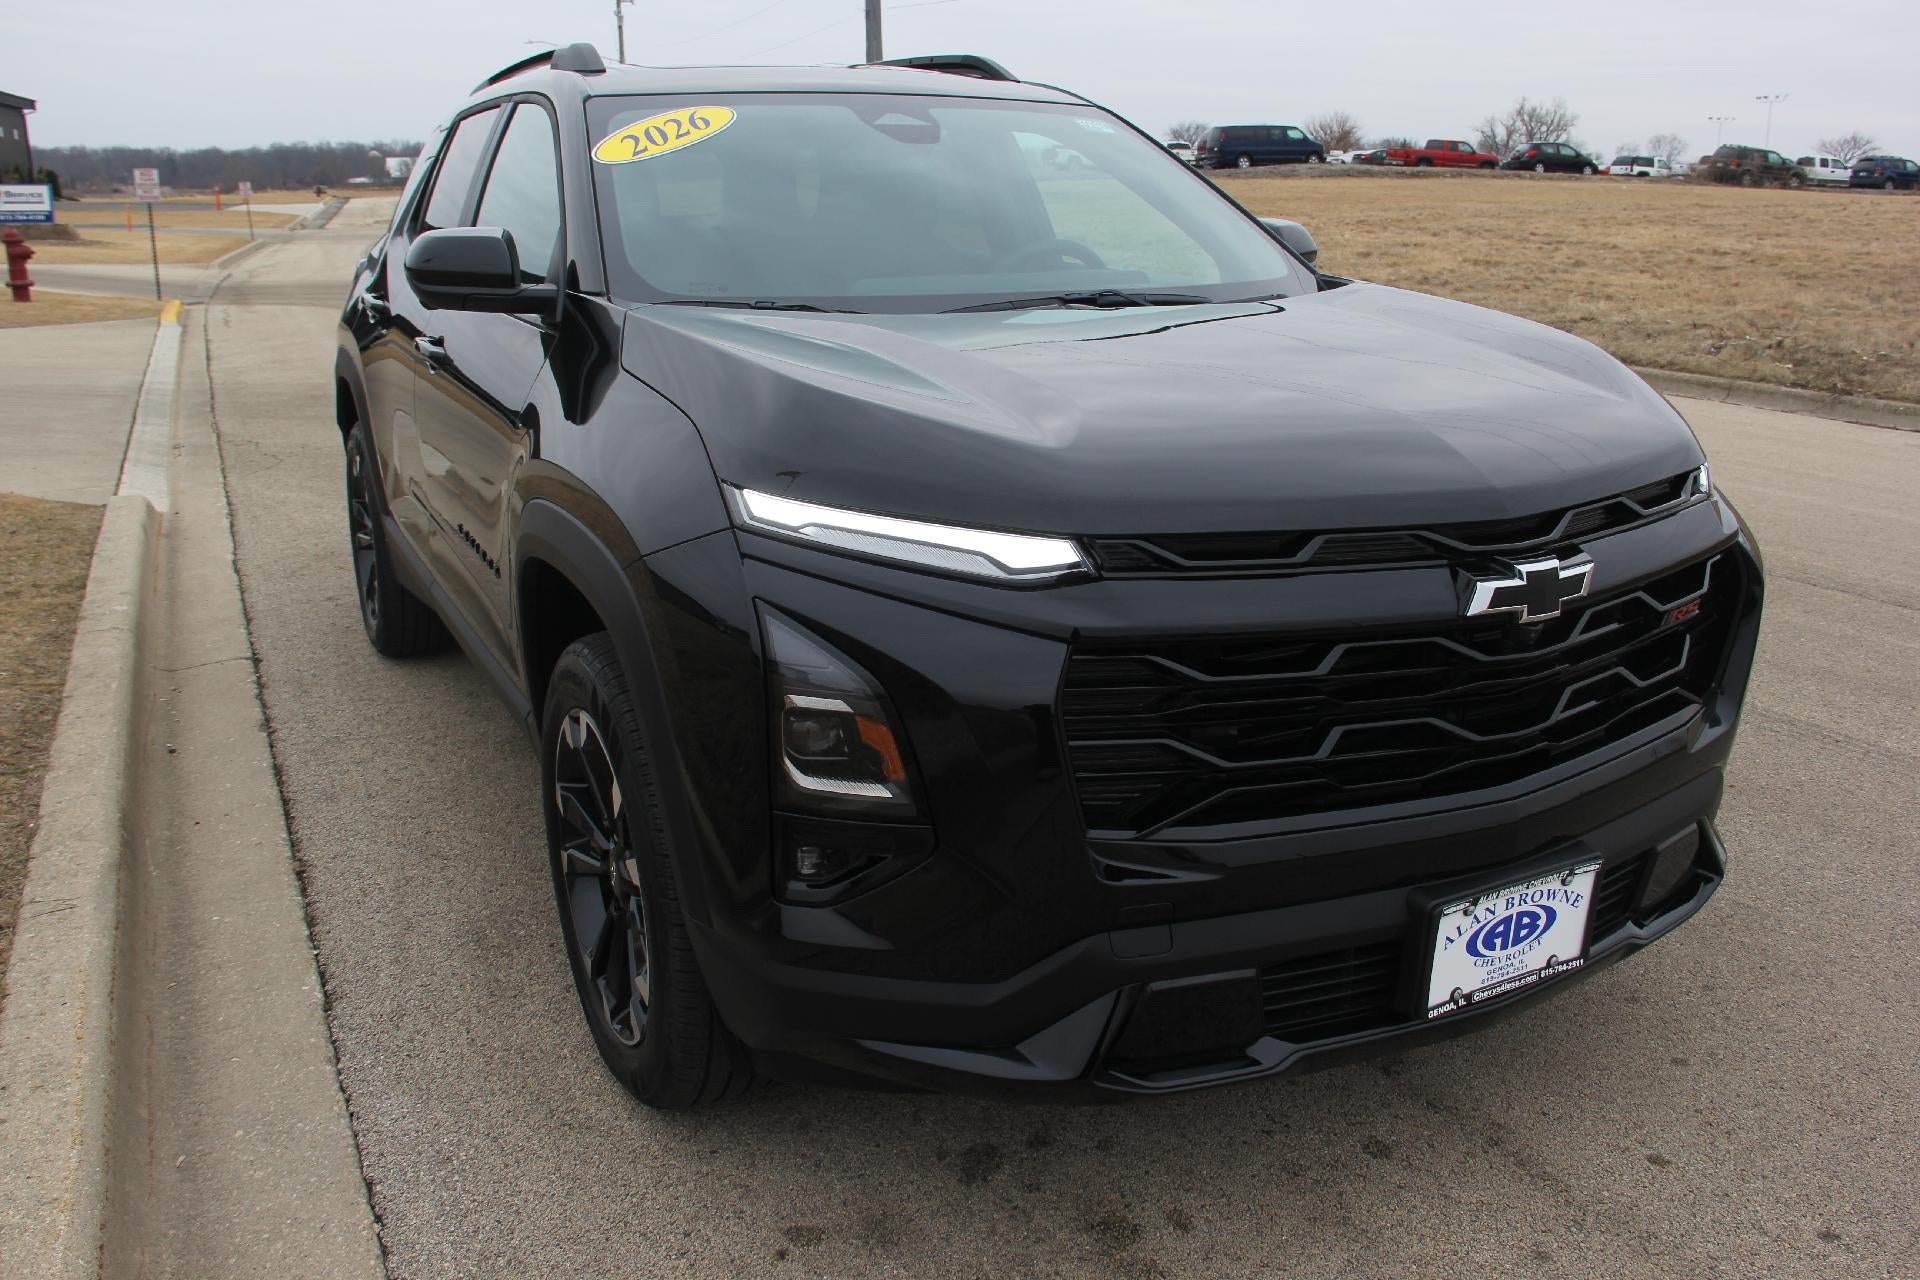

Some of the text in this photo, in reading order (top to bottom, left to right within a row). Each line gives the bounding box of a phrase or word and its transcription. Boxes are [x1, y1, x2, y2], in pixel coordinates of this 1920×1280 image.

[620, 110, 711, 157] 2026
[1443, 902, 1497, 951] ALAN
[1504, 888, 1584, 911] BROWNE
[1473, 937, 1543, 968] CHEVROLET
[1486, 962, 1516, 976] GENOA,
[1540, 958, 1585, 978] 815-784-2511
[1428, 998, 1467, 1019] GENOA, IL
